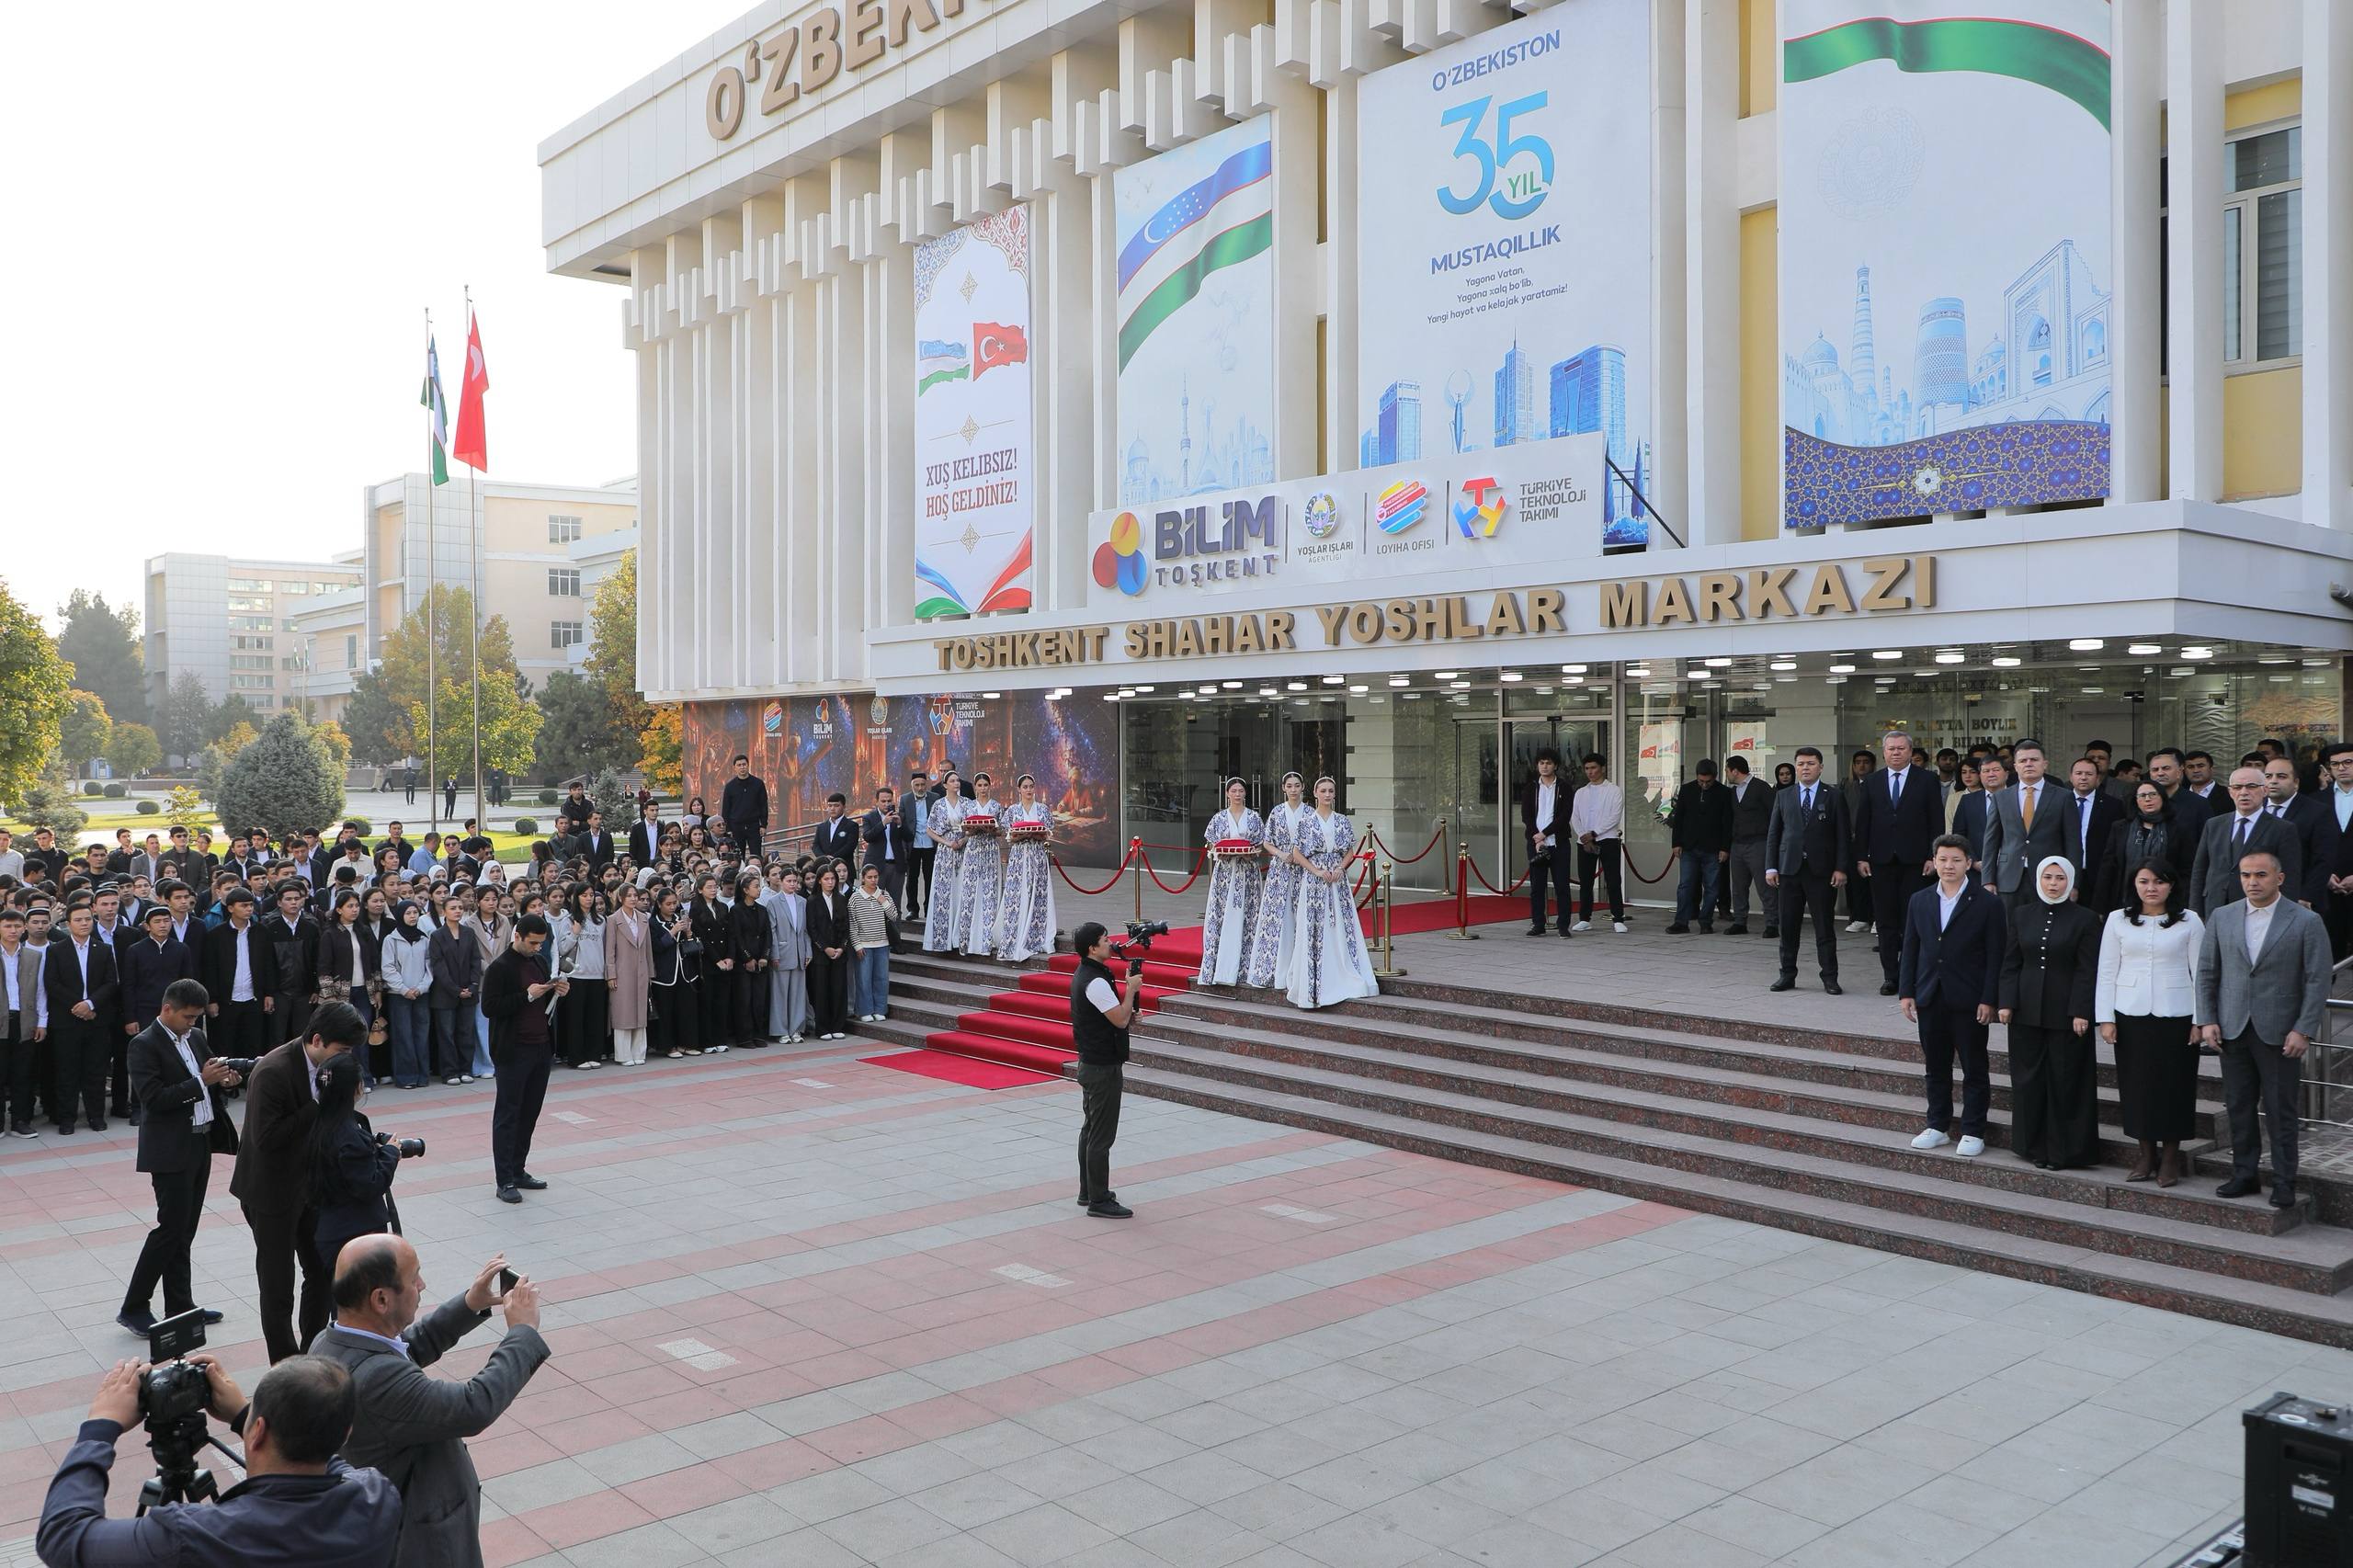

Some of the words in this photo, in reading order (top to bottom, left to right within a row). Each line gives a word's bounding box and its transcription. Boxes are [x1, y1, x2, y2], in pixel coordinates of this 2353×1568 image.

[706, 0, 964, 141] O‘ZBEK
[1432, 29, 1561, 91] O‘ZBEKISTON
[1437, 90, 1555, 221] 35
[1507, 171, 1541, 199] YIL
[1431, 224, 1561, 275] MUSTAQILLIK
[1457, 290, 1487, 303] Yagona
[1489, 284, 1507, 295] xalq
[1465, 273, 1495, 287] Yagona
[1497, 267, 1525, 278] Vatan,
[1427, 312, 1449, 324] Yangi
[1450, 306, 1473, 320] hayot
[1476, 304, 1486, 312] va
[1487, 296, 1519, 310] kelajak
[1521, 284, 1568, 304] yaratamiz!
[926, 462, 949, 490] XUŞ
[952, 448, 1017, 482] KELIBSIZ!
[926, 494, 949, 521] HOŞ
[952, 476, 1017, 513] GELDİNİZ!
[1519, 506, 1559, 523] TAKIMI
[1298, 544, 1327, 558] YOŞLAR
[1328, 541, 1354, 554] IŞLARI
[1377, 541, 1409, 555] LOYIHA
[1411, 539, 1435, 552] OFISI
[1155, 554, 1278, 587] TOŞKENT
[934, 627, 1109, 671] TOSHKENT
[1124, 611, 1295, 658] SHAHAR
[1314, 589, 1566, 646] YOSHLAR
[1599, 556, 1937, 629] MARKAZI
[1972, 718, 2017, 731] BOYLIK
